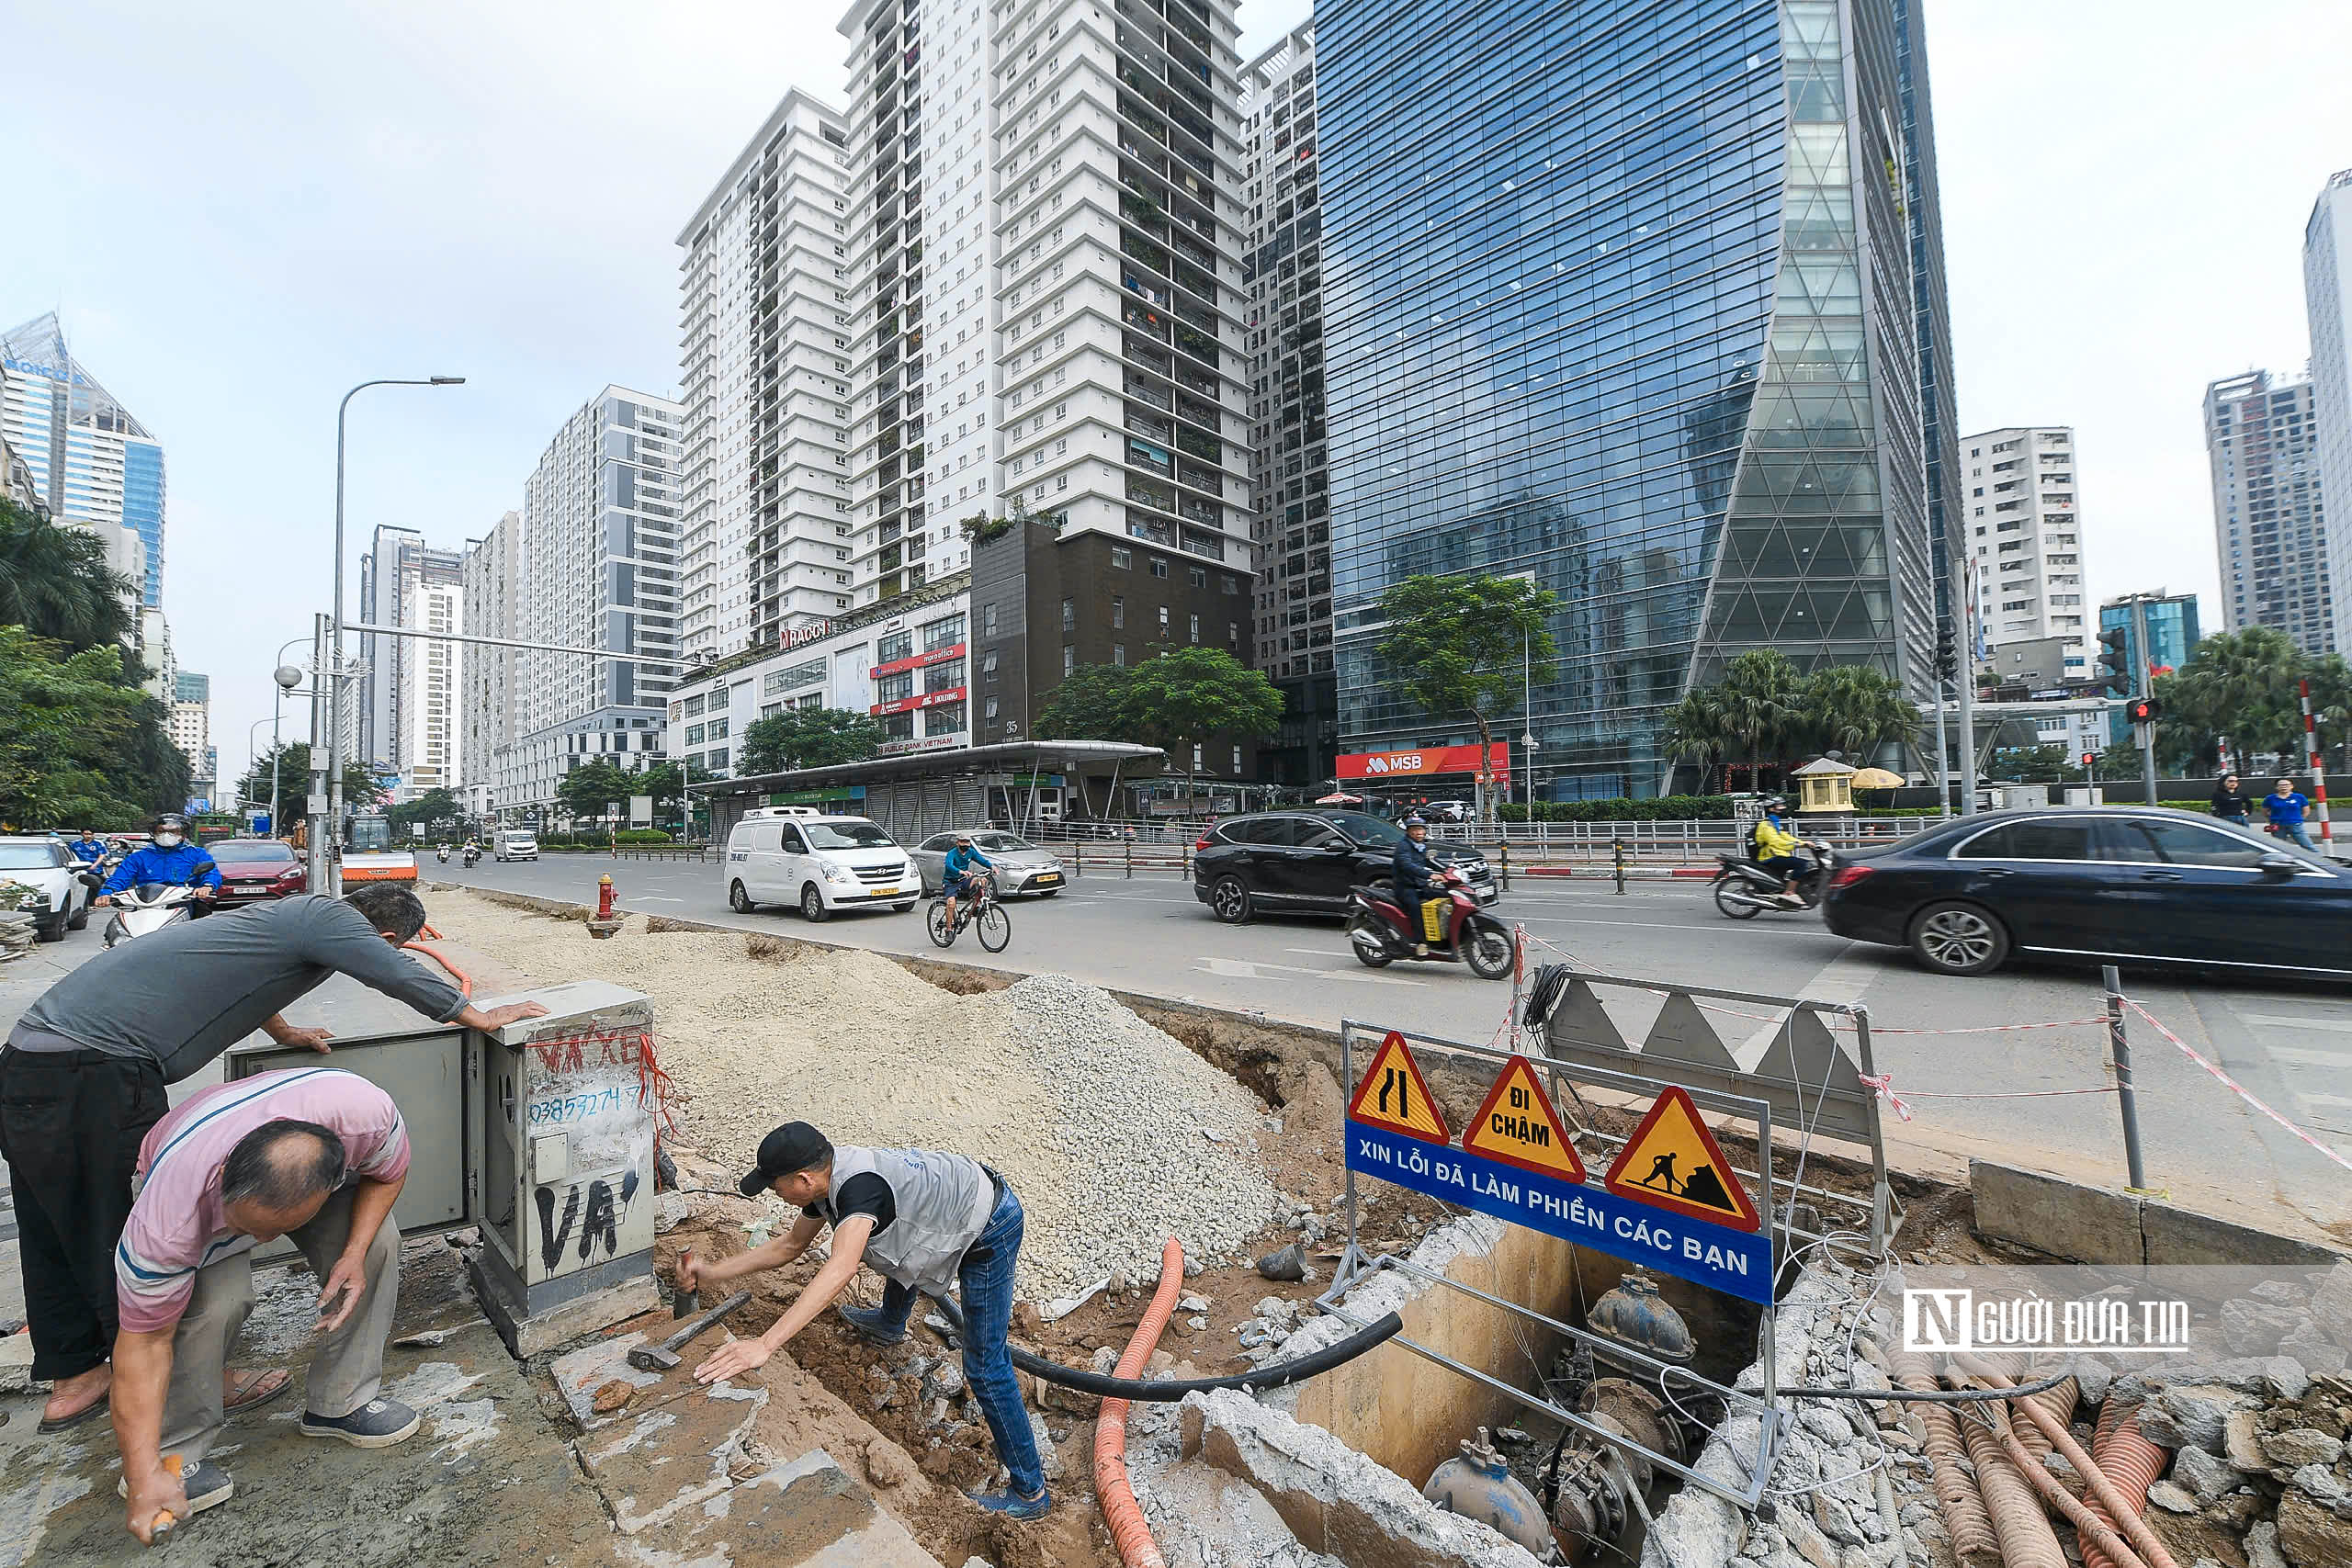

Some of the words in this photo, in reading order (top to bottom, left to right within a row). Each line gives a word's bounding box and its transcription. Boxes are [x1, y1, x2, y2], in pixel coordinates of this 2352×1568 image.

[1006, 720, 1018, 734] 35
[884, 745, 903, 754] PUBLIC
[923, 737, 953, 748] VIETNAM
[1390, 755, 1422, 771] MSB
[1510, 1086, 1530, 1111] ĐI
[1491, 1112, 1550, 1147] CHẬM
[1360, 1139, 1390, 1164] XIN
[1397, 1147, 1429, 1177] LỖI
[1435, 1162, 1465, 1188] ĐÃ
[1472, 1172, 1520, 1204] LÀM
[1528, 1187, 1604, 1231] PHIỀN
[1614, 1218, 1672, 1251] CÁC
[1683, 1236, 1747, 1276] BẠN
